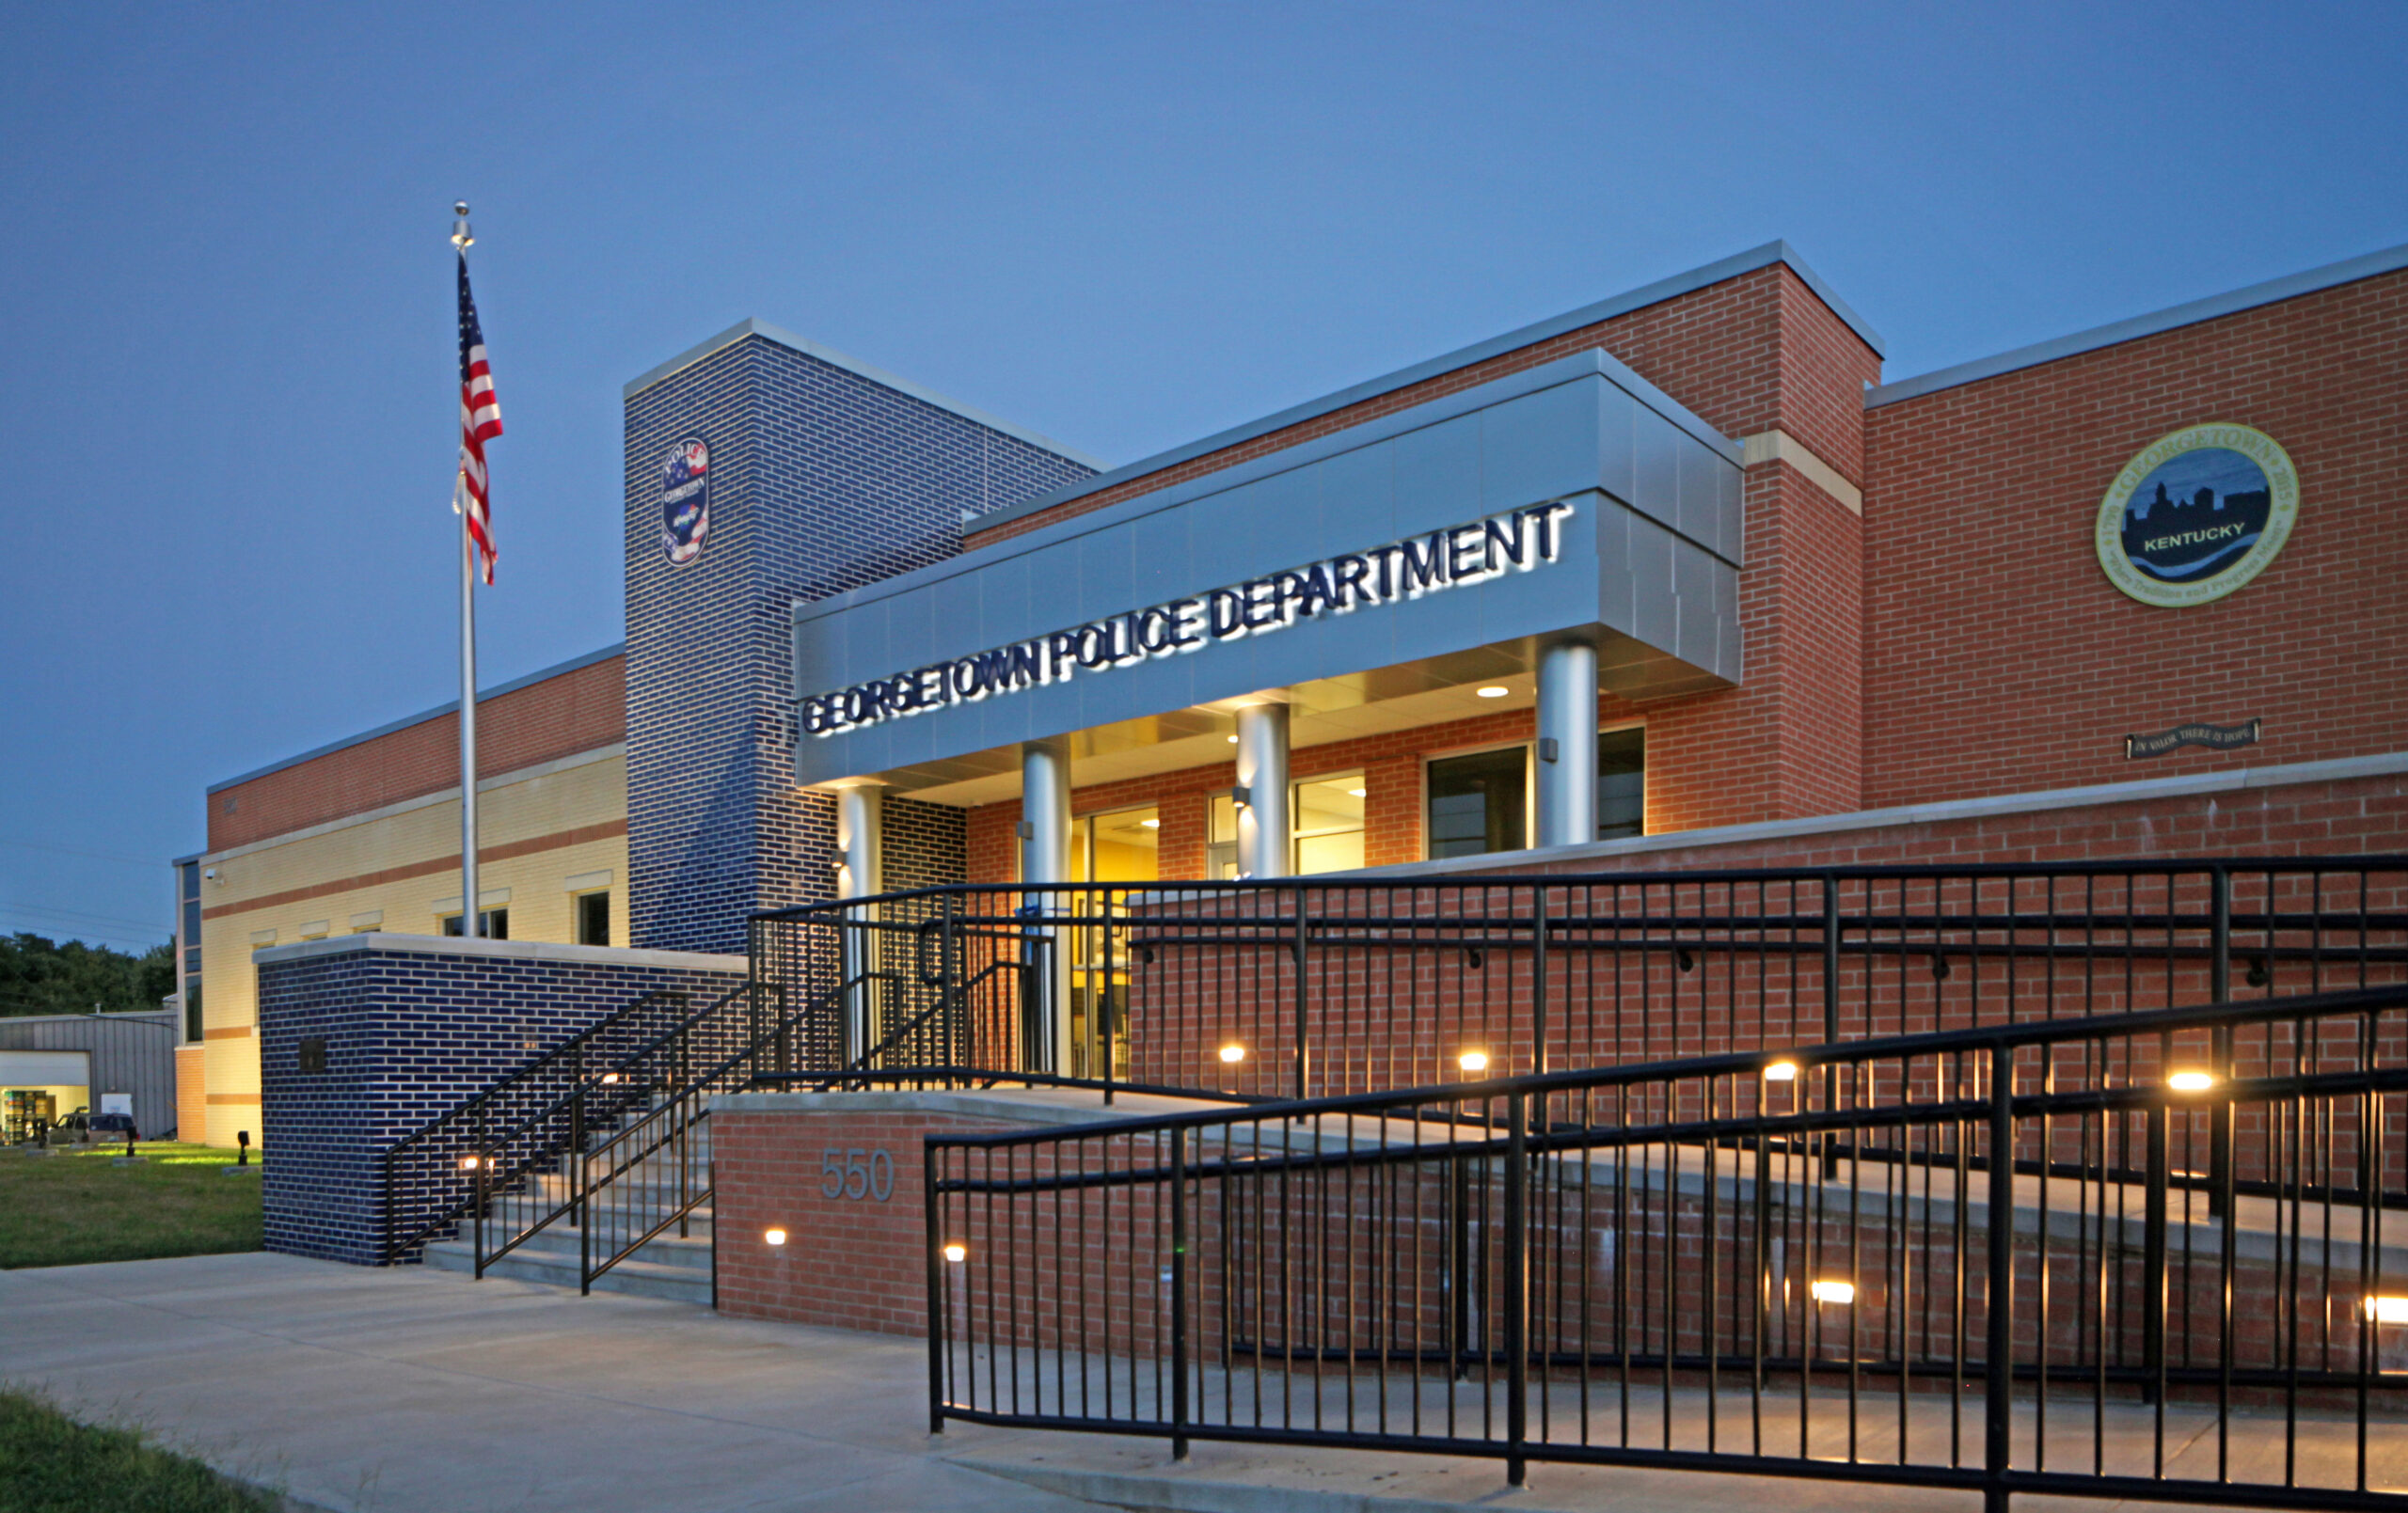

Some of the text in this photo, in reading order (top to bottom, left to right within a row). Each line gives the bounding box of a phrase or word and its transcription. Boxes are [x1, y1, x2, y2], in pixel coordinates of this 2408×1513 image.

[664, 443, 705, 474] POLICE
[2120, 430, 2276, 491] GEORGETOWN
[2144, 522, 2245, 552] KENTUCKY
[802, 501, 1574, 737] GEORGETOWN POLICE DEPARTMENT
[2179, 728, 2211, 739] THERE
[822, 1148, 894, 1202] 550
